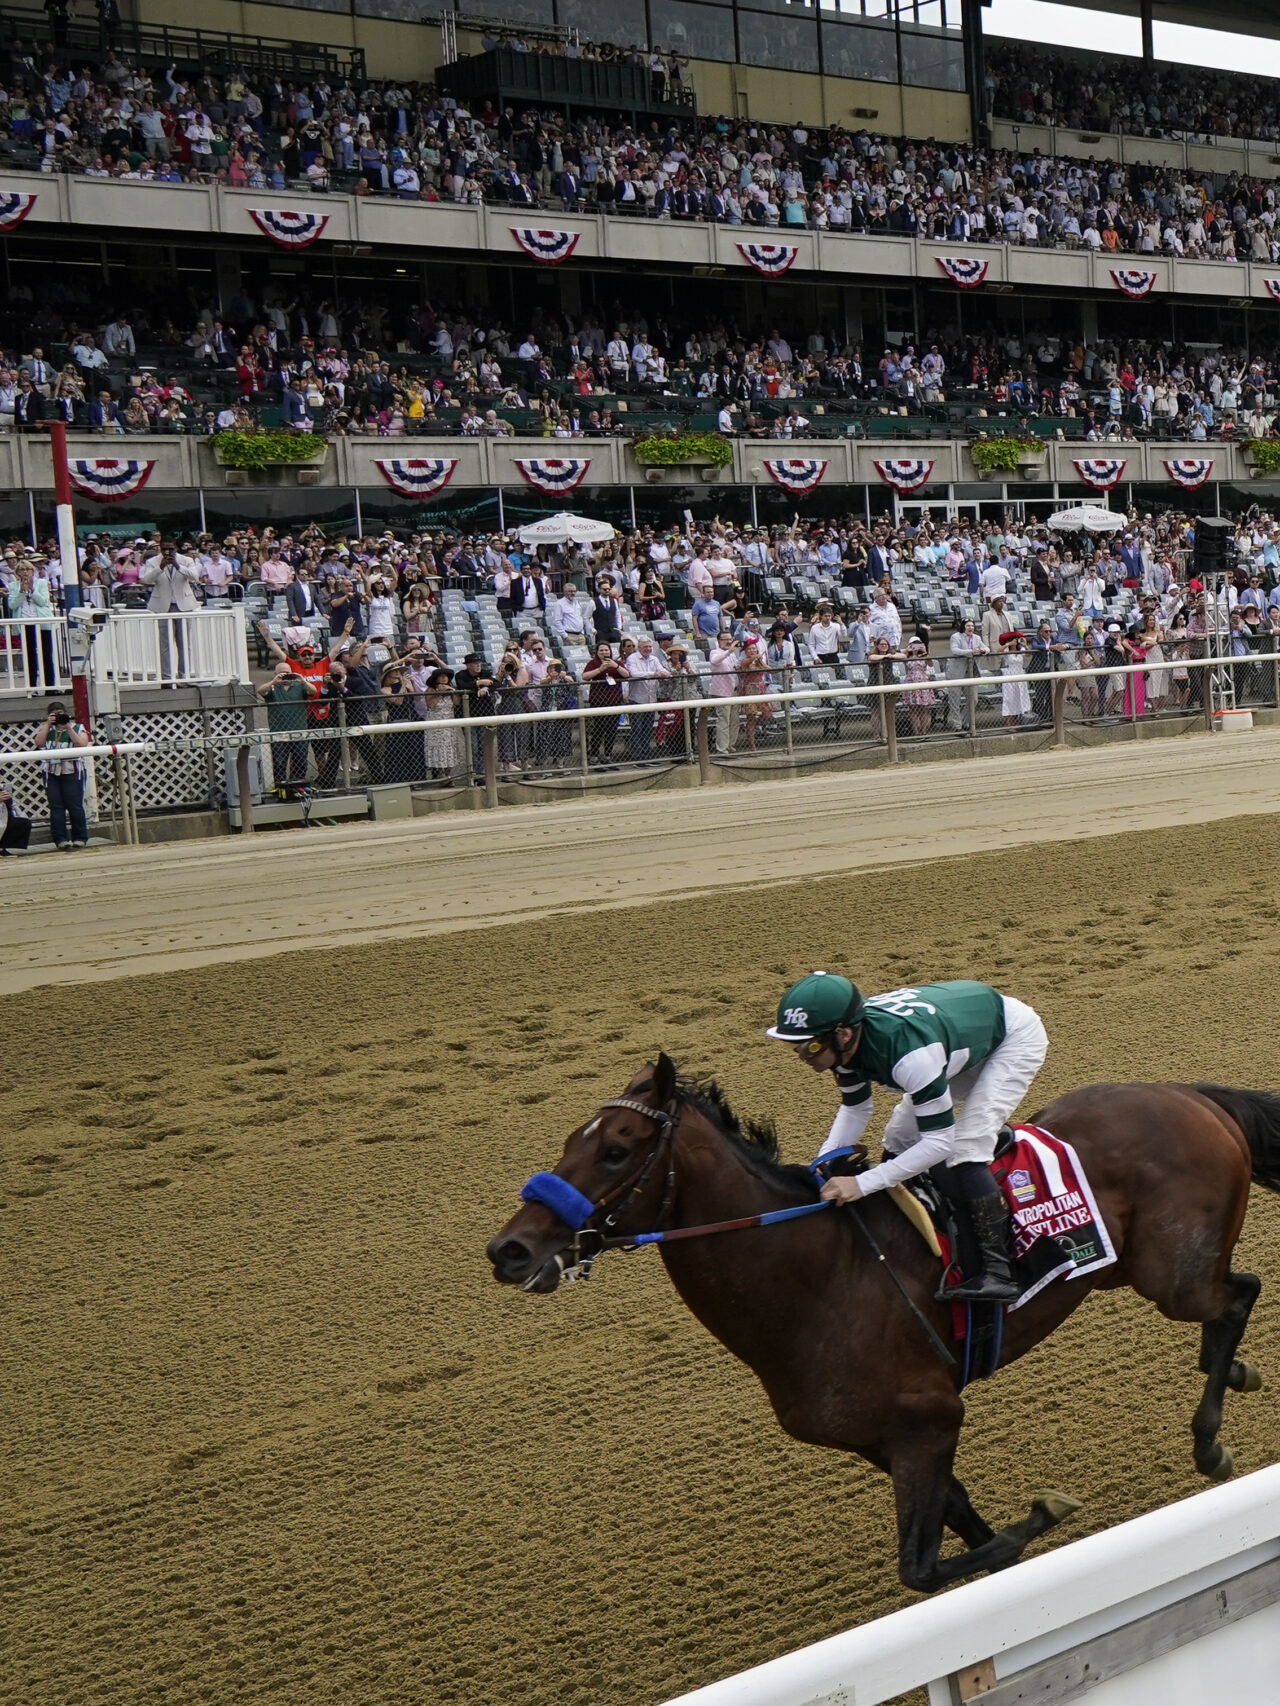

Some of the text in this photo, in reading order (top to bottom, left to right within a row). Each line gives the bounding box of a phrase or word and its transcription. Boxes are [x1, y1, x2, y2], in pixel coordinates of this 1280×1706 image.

[154, 726, 352, 751] BELMONT PARK
[783, 1007, 809, 1029] HR
